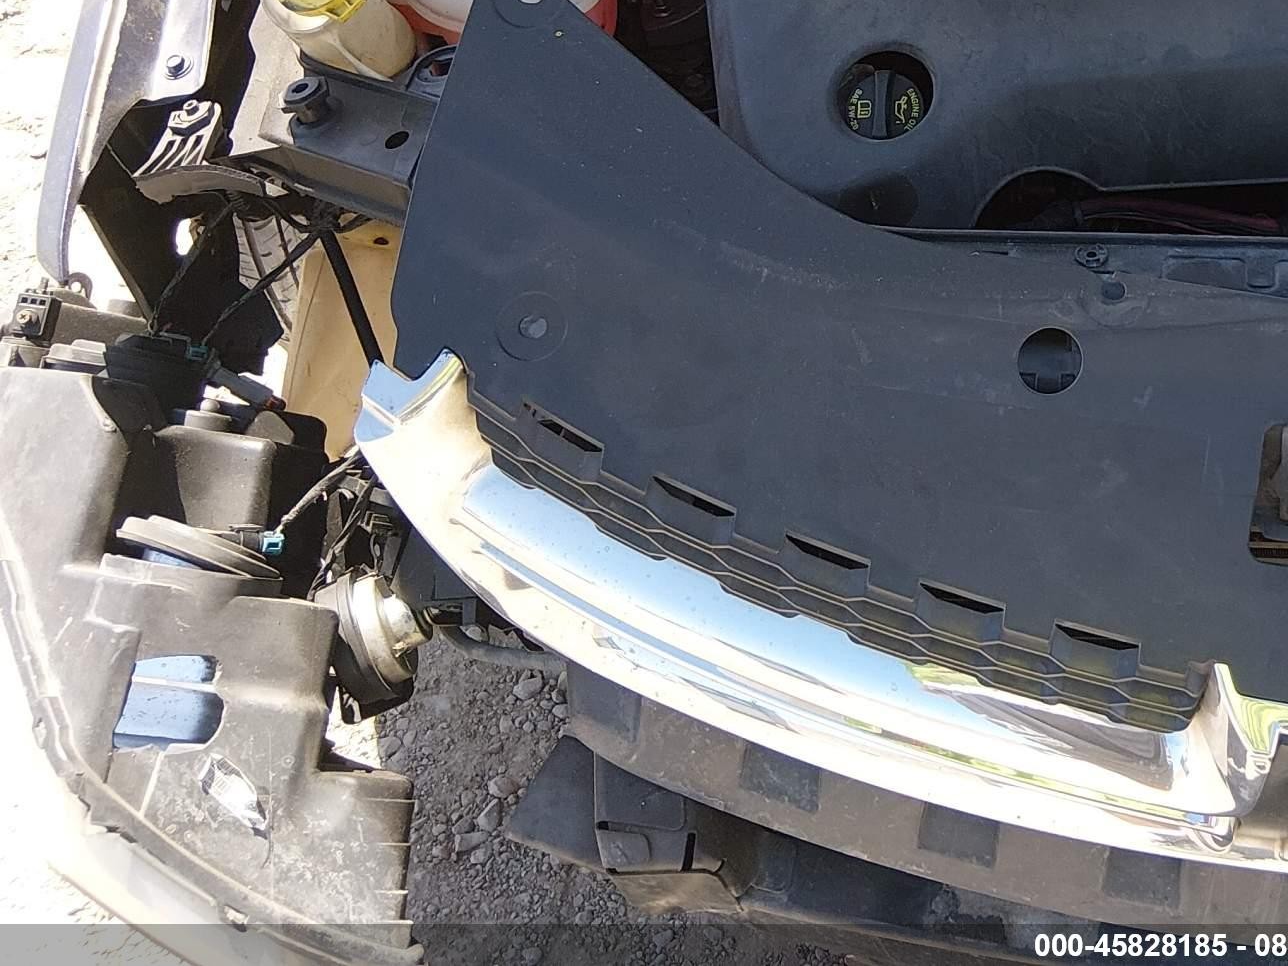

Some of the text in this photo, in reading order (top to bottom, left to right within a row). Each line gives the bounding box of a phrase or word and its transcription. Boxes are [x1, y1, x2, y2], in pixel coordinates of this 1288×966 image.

[848, 88, 863, 130] SAE 5W-20
[903, 88, 920, 131] ENGINE OIL
